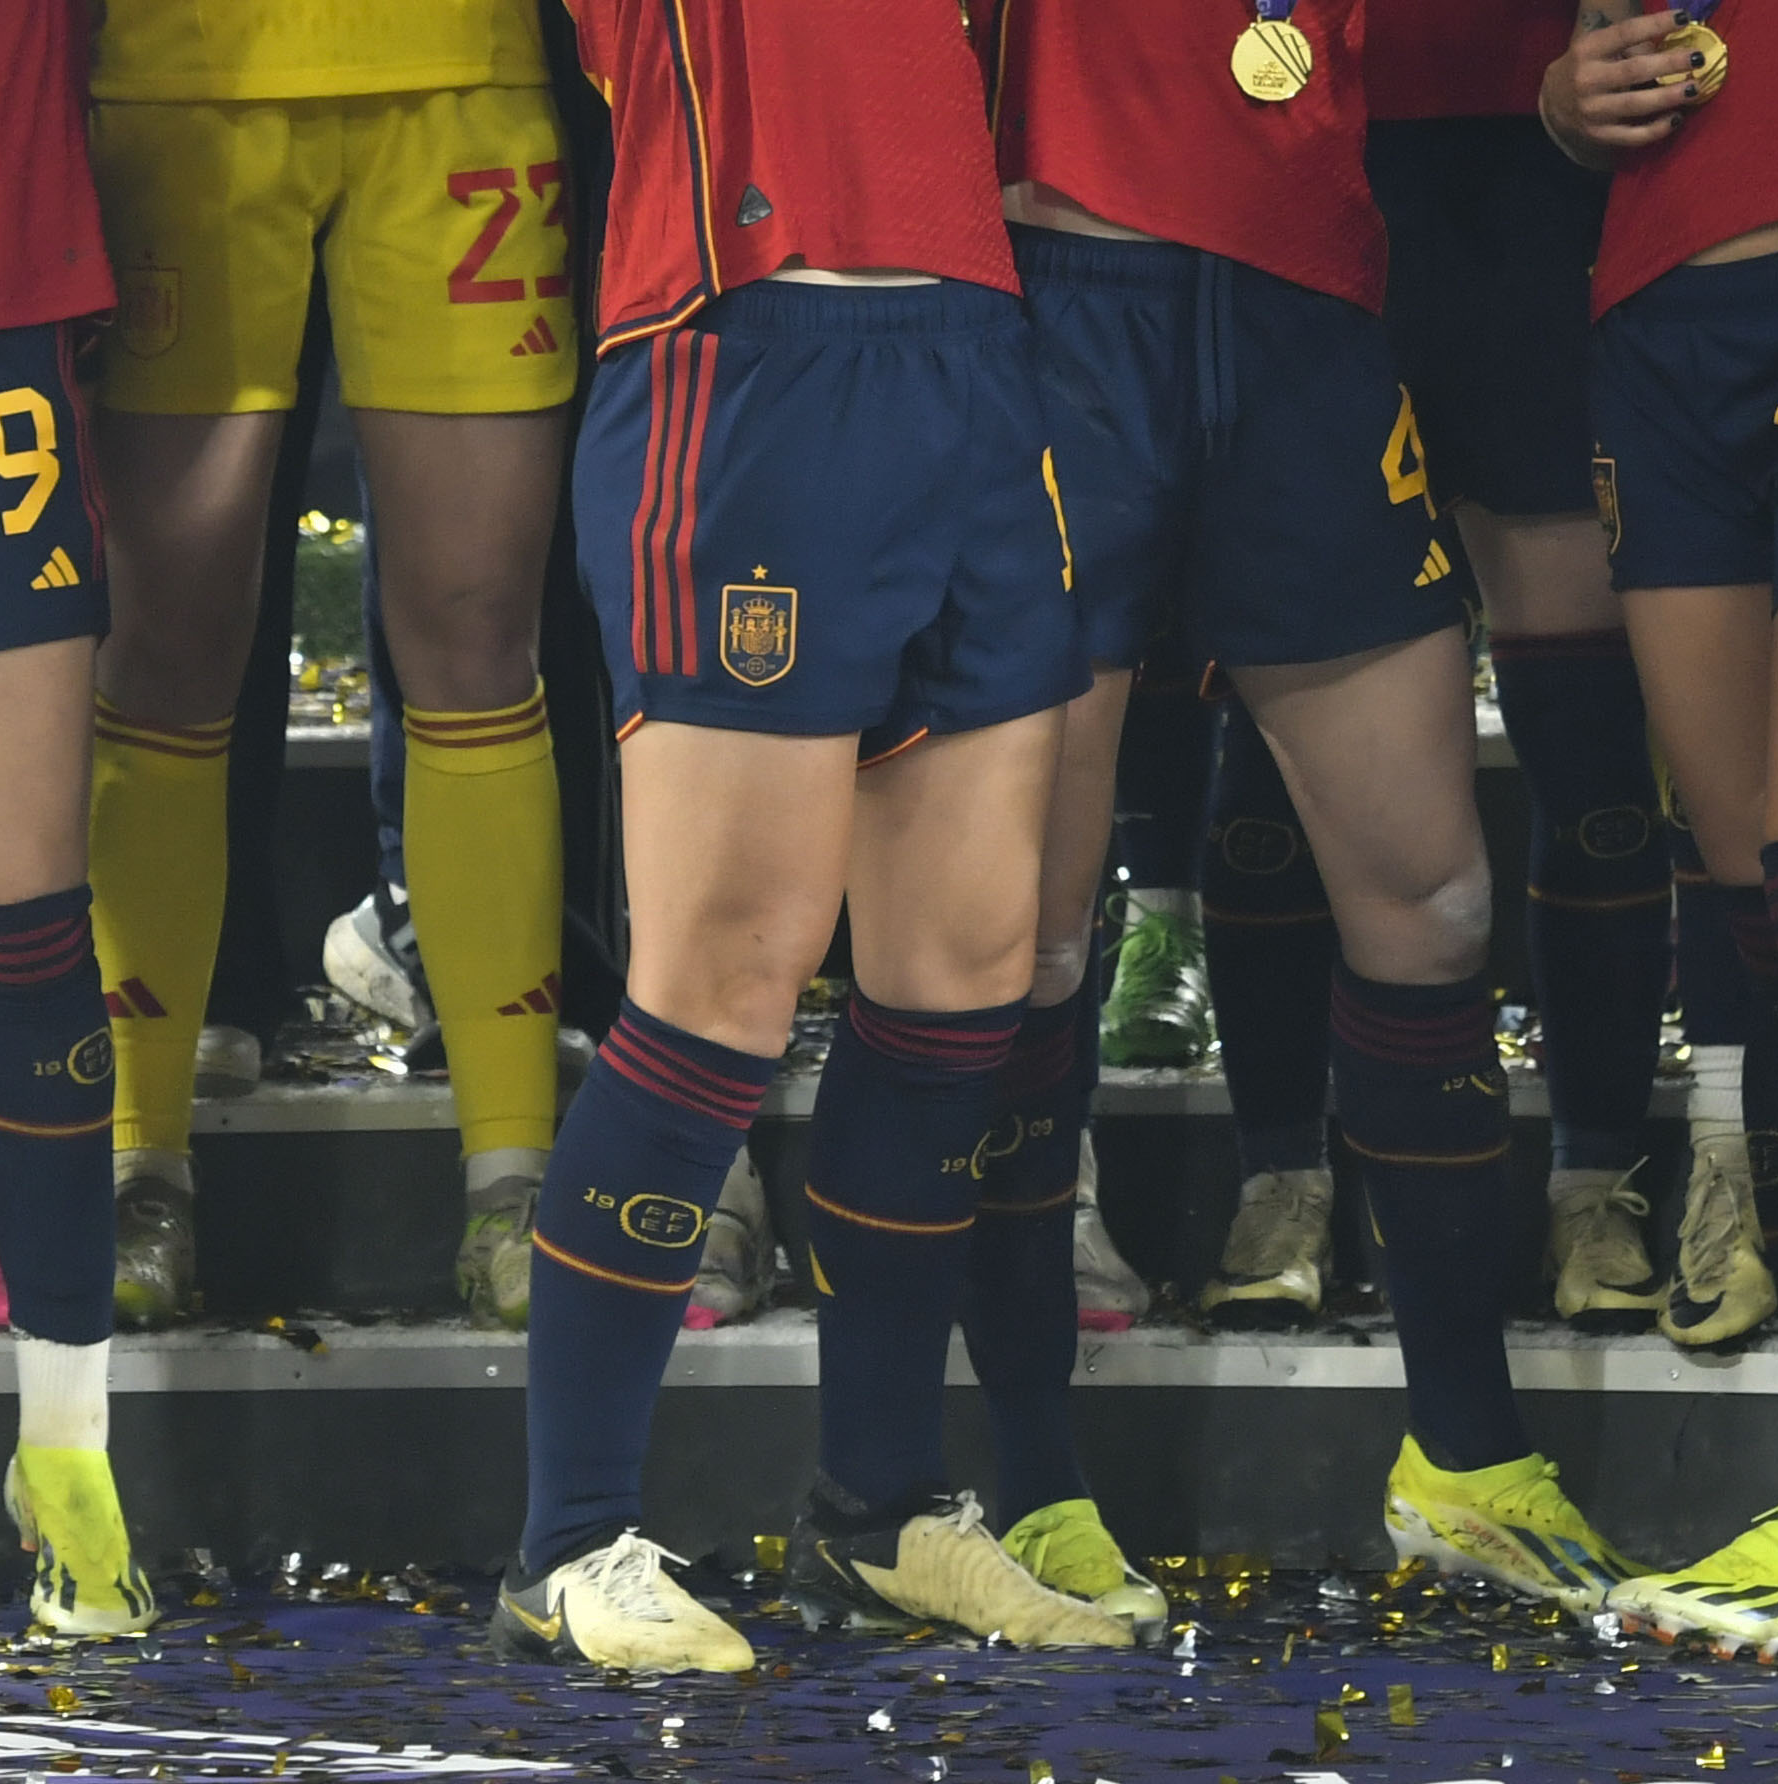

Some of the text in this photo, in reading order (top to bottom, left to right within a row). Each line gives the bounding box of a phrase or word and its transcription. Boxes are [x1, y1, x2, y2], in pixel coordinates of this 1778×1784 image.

[1380, 382, 1437, 523] 4
[33, 1059, 62, 1077] 19
[940, 1156, 968, 1175] 19
[583, 1185, 616, 1210] 19
